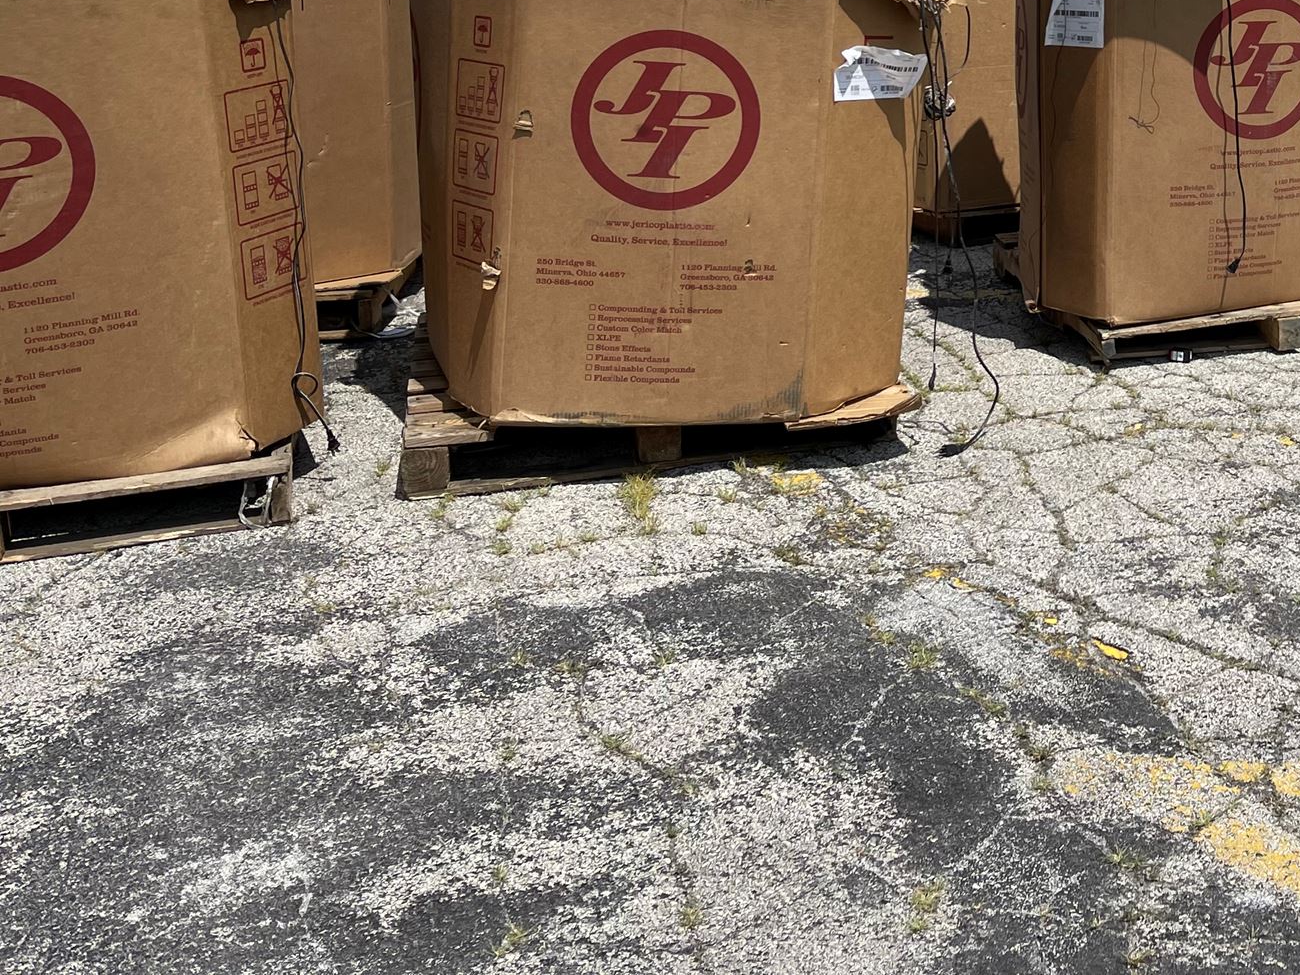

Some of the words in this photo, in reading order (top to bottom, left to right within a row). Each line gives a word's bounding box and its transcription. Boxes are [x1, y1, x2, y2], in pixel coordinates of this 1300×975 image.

[594, 60, 737, 179] JPI
[1221, 146, 1296, 157] wwwjericopastic.com
[1210, 161, 1237, 171] Quality
[590, 234, 631, 246] Quality,
[632, 236, 671, 247] Service,
[672, 238, 728, 247] Excellence!
[536, 258, 554, 266] 250
[555, 258, 585, 268] Bridge
[586, 259, 597, 267] St.
[536, 268, 574, 277] Minerva,
[575, 269, 596, 277] Ohio
[680, 264, 702, 272] 1120
[704, 264, 744, 274] Planning
[680, 273, 731, 283] Greensboro,
[733, 274, 747, 282] GA
[8, 292, 75, 309] Excellence!
[598, 305, 658, 315] Compounding
[669, 306, 685, 314] Toll
[687, 306, 723, 314] Services
[23, 324, 49, 334] 1120
[51, 316, 99, 330] Planning
[101, 312, 121, 322] Mill
[123, 309, 140, 318] Rd.
[597, 315, 656, 325] Reprocessing
[657, 316, 692, 324] Services
[23, 330, 87, 345] Greensboro,
[88, 326, 105, 336] GA
[107, 319, 139, 332] 30642
[596, 324, 629, 333] Custom
[630, 325, 654, 333] Color
[656, 326, 682, 334] Match
[25, 338, 96, 355] 706-453-2303
[595, 344, 620, 352] Stone
[621, 344, 651, 353] Effects
[595, 354, 621, 362] Flame
[623, 355, 670, 363] Retardants
[4, 376, 13, 384] &
[15, 372, 36, 382] Toll
[38, 366, 82, 378] Services
[594, 364, 645, 373] Sustainable
[645, 365, 696, 375] Compounds
[593, 374, 629, 383] Flexible
[630, 375, 680, 385] Compounds
[2, 383, 47, 395] Services
[4, 394, 36, 405] Match
[0, 427, 27, 437] dants
[0, 445, 42, 459] pounds
